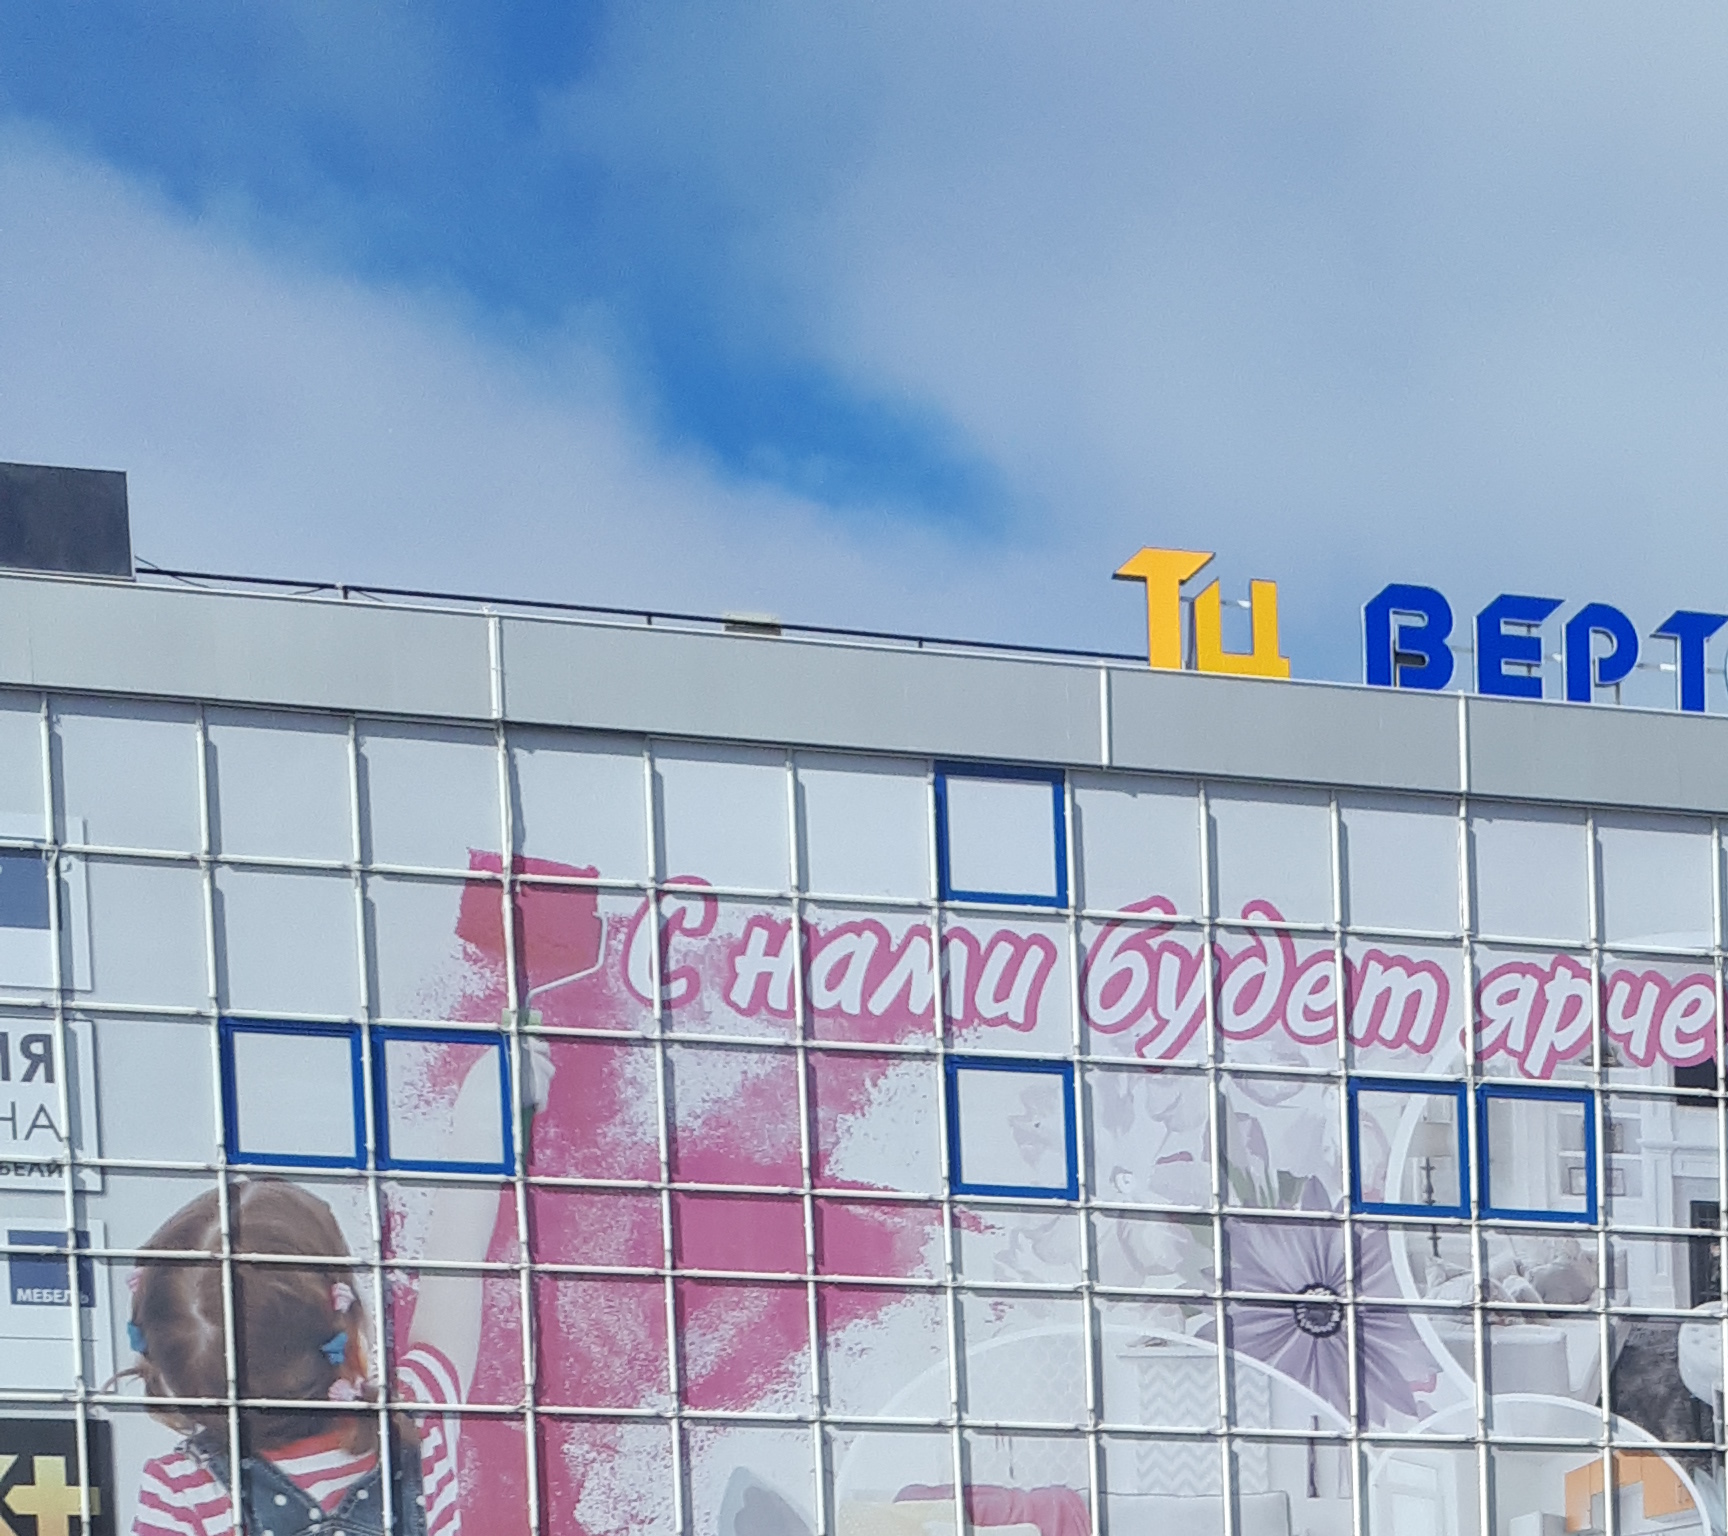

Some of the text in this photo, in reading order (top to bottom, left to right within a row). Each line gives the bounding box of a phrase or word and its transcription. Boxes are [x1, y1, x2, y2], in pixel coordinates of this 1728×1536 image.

[1111, 546, 1290, 678] ТЦ
[624, 877, 716, 1007] С
[727, 913, 1057, 1034] нами
[1079, 896, 1448, 1073] будет
[16, 1287, 89, 1304] МЕБЕЛЬ
